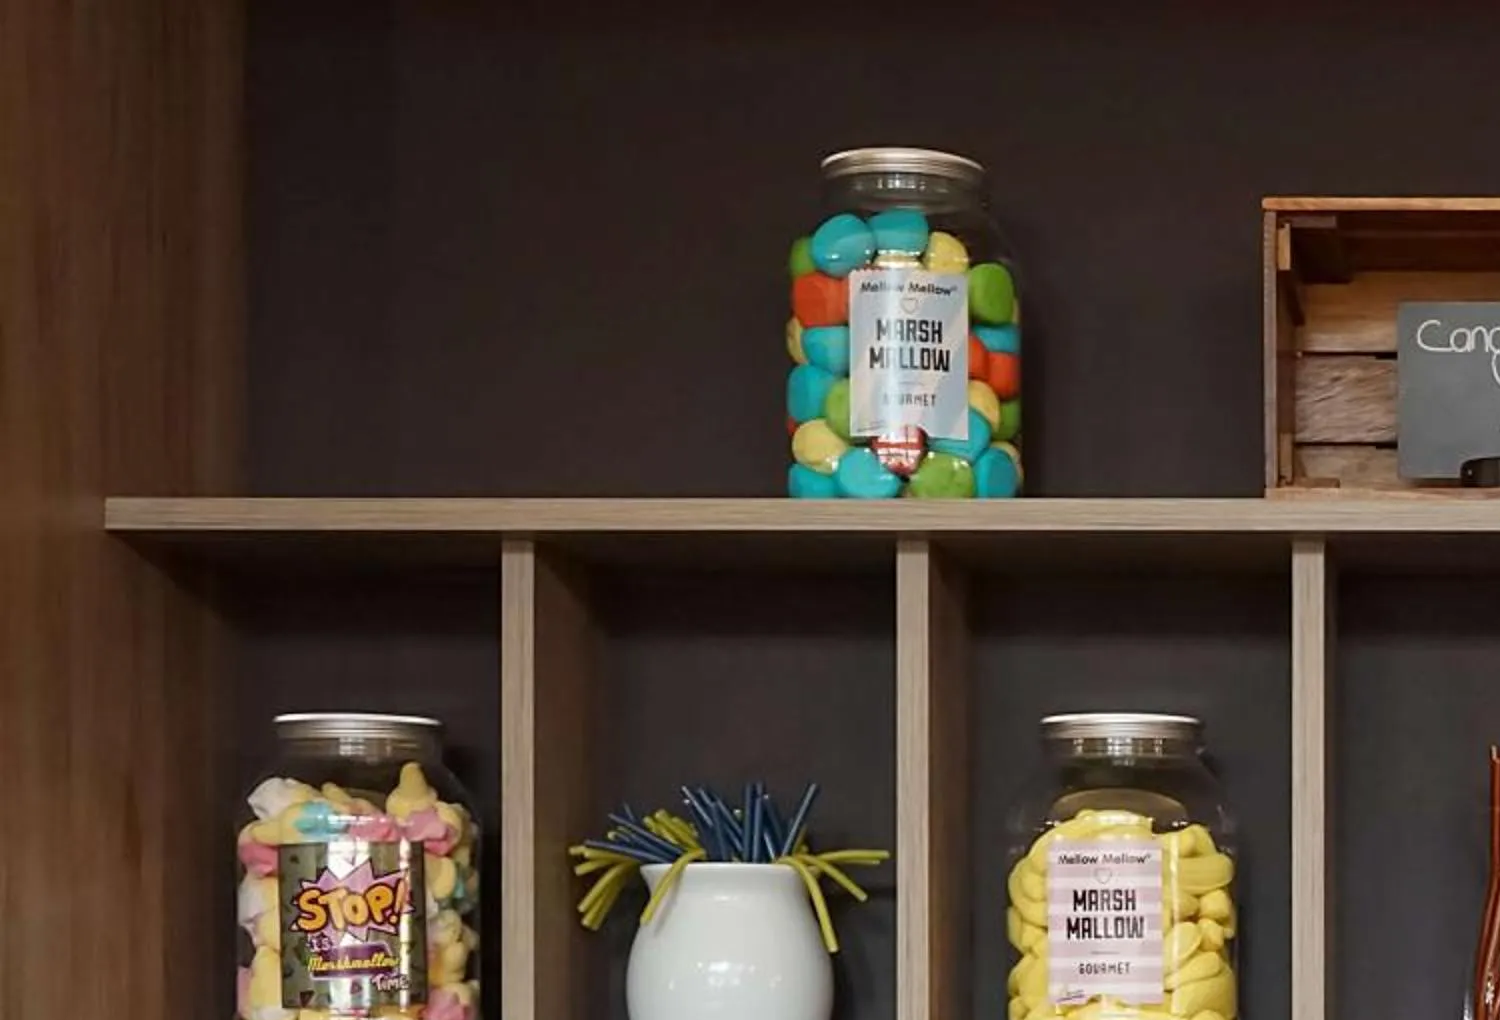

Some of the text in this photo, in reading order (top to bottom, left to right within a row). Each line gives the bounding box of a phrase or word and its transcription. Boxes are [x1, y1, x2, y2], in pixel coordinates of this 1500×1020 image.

[861, 281, 904, 293] Mellw
[877, 318, 943, 344] MARSH
[882, 393, 937, 407] URMET
[1058, 853, 1146, 865] Mellow Mellow
[296, 876, 409, 932] STOP!
[1072, 889, 1137, 912] MARSH
[1066, 916, 1145, 940] MALLOW
[1078, 962, 1131, 975] GOURMET
